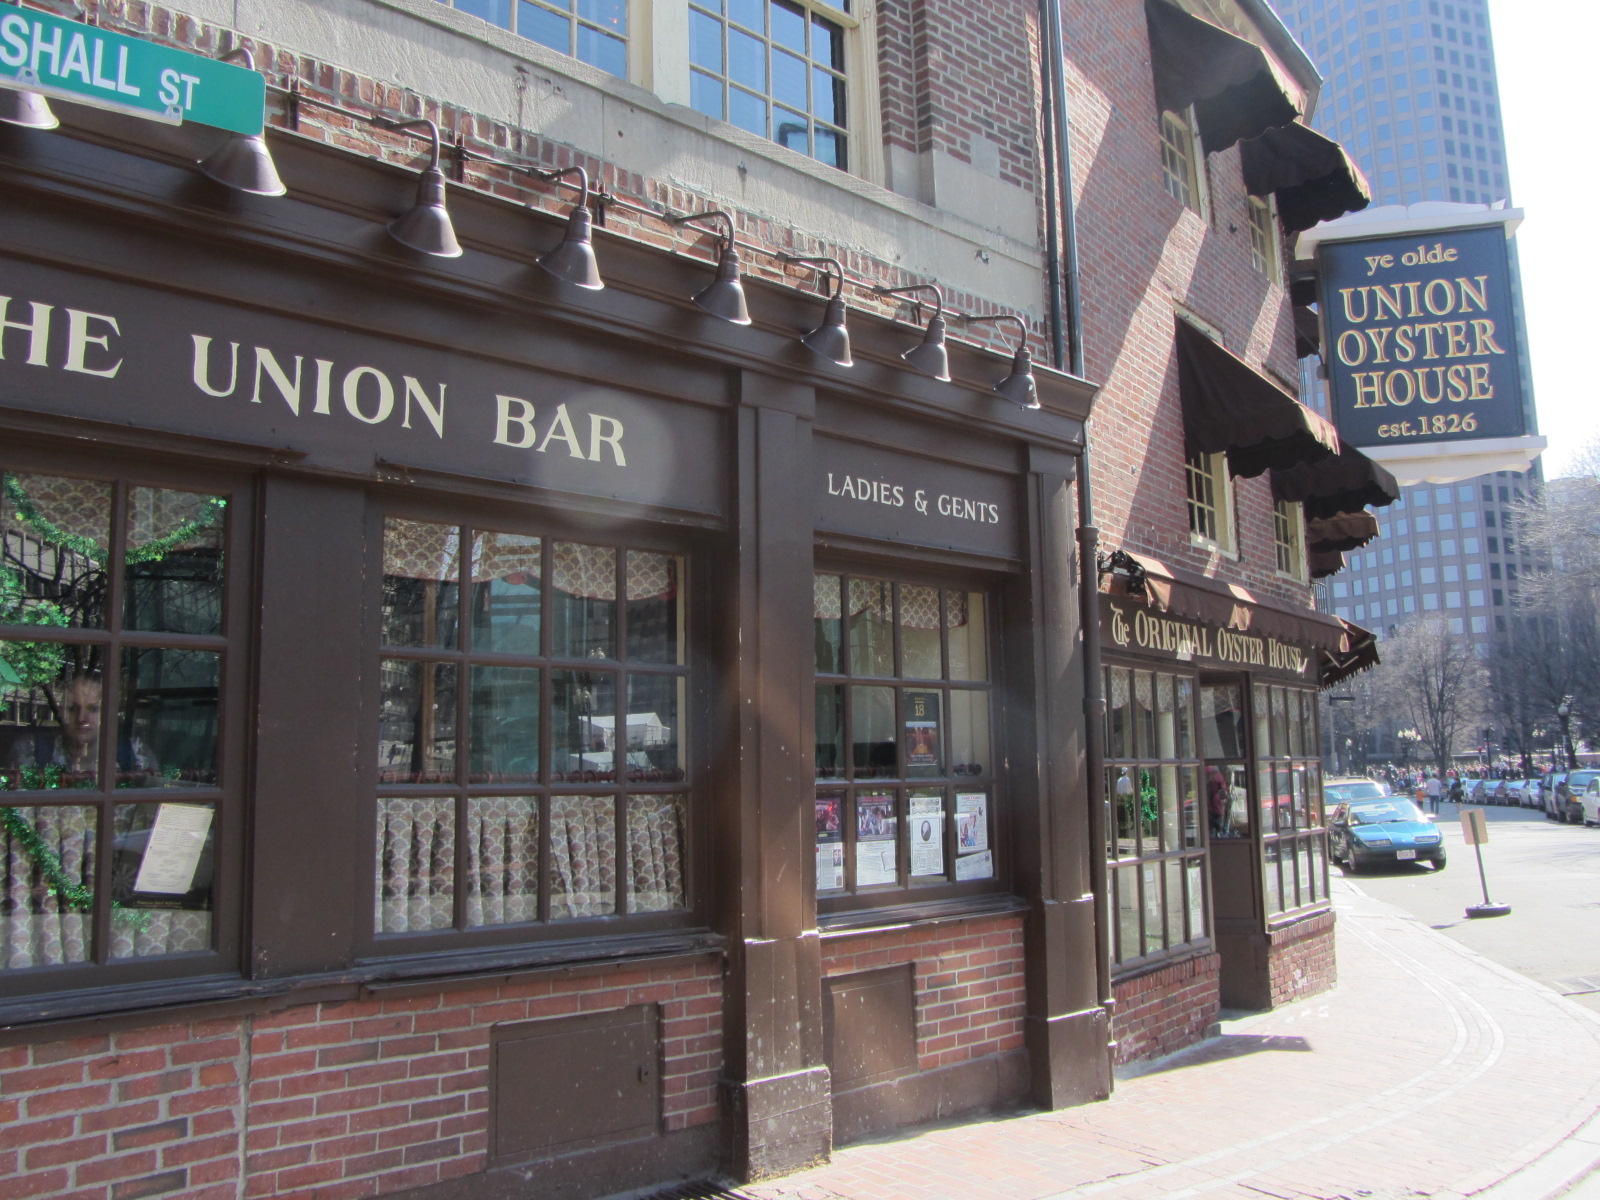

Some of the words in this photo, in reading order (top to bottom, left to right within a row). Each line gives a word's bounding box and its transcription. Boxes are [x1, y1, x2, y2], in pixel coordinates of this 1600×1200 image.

[0, 14, 141, 98] SHALL
[159, 68, 200, 111] ST
[1365, 253, 1394, 276] ye
[1401, 243, 1459, 267] olde
[1339, 275, 1488, 324] UNION
[1336, 318, 1505, 367] OYSTER
[191, 334, 447, 440] UNION
[492, 394, 627, 467] BAR
[1351, 362, 1494, 409] HOUSE
[1377, 412, 1478, 438] est.1826
[827, 472, 905, 507] LADIES
[914, 489, 928, 517] &
[937, 494, 1000, 525] GENTS
[1110, 602, 1130, 648] The
[1134, 610, 1213, 657] ORIGINAL
[1217, 627, 1265, 666] OYSTER
[1267, 637, 1308, 674] HOUSE
